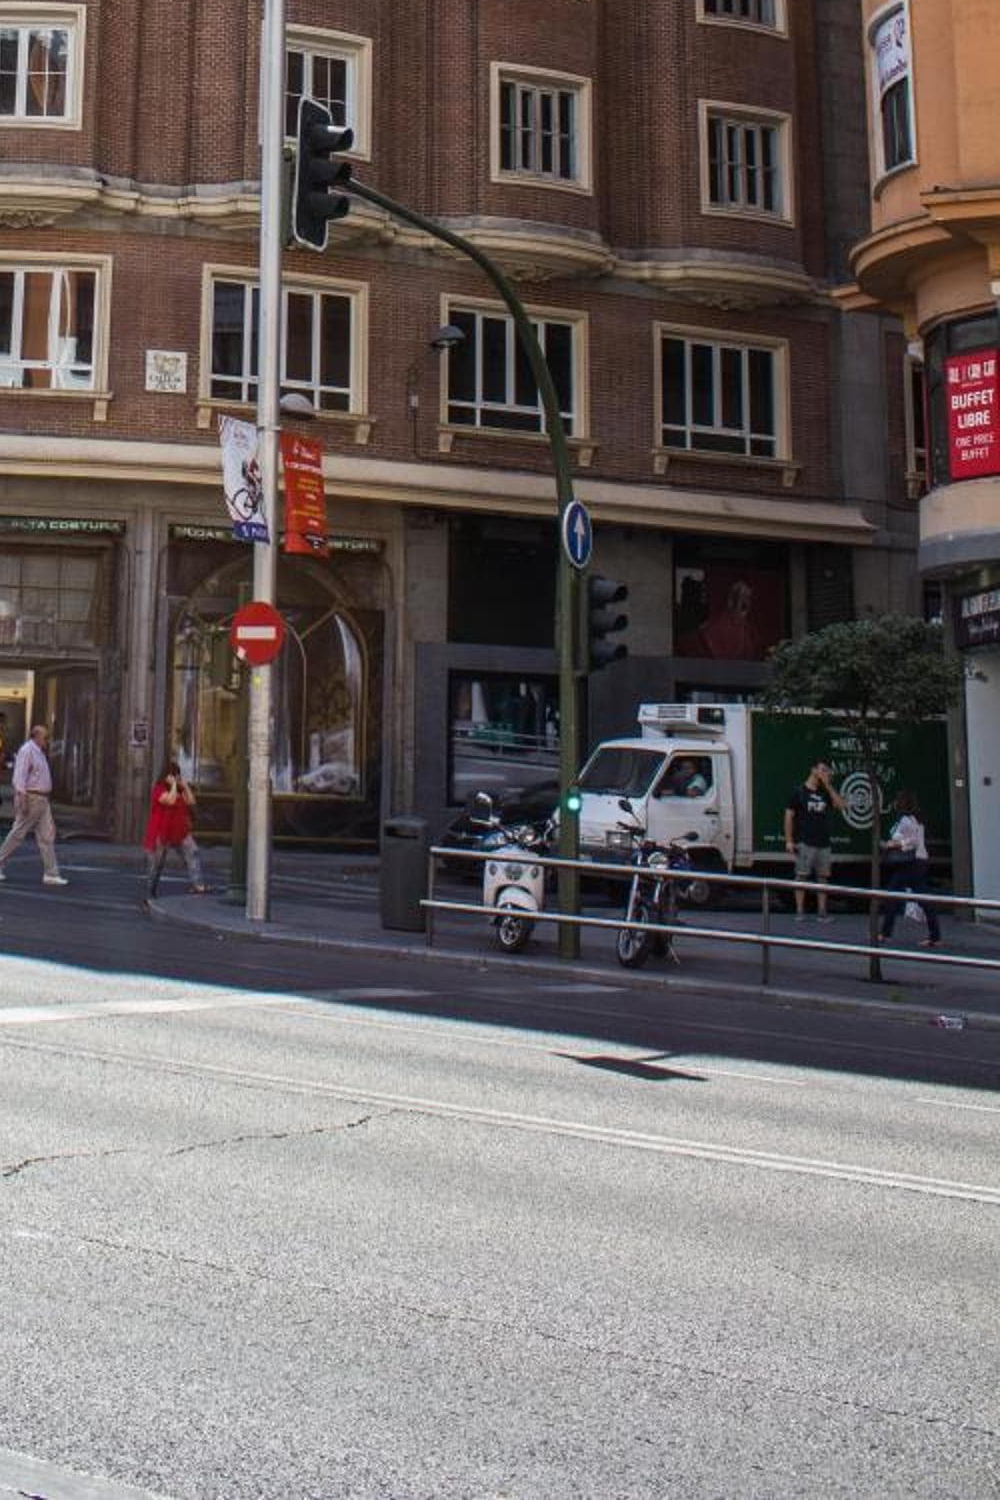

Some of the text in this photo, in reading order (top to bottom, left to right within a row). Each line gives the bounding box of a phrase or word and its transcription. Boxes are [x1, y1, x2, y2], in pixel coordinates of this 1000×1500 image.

[951, 388, 995, 410] BUFFET
[957, 409, 991, 429] LIBRE
[961, 446, 990, 461] BUFFET
